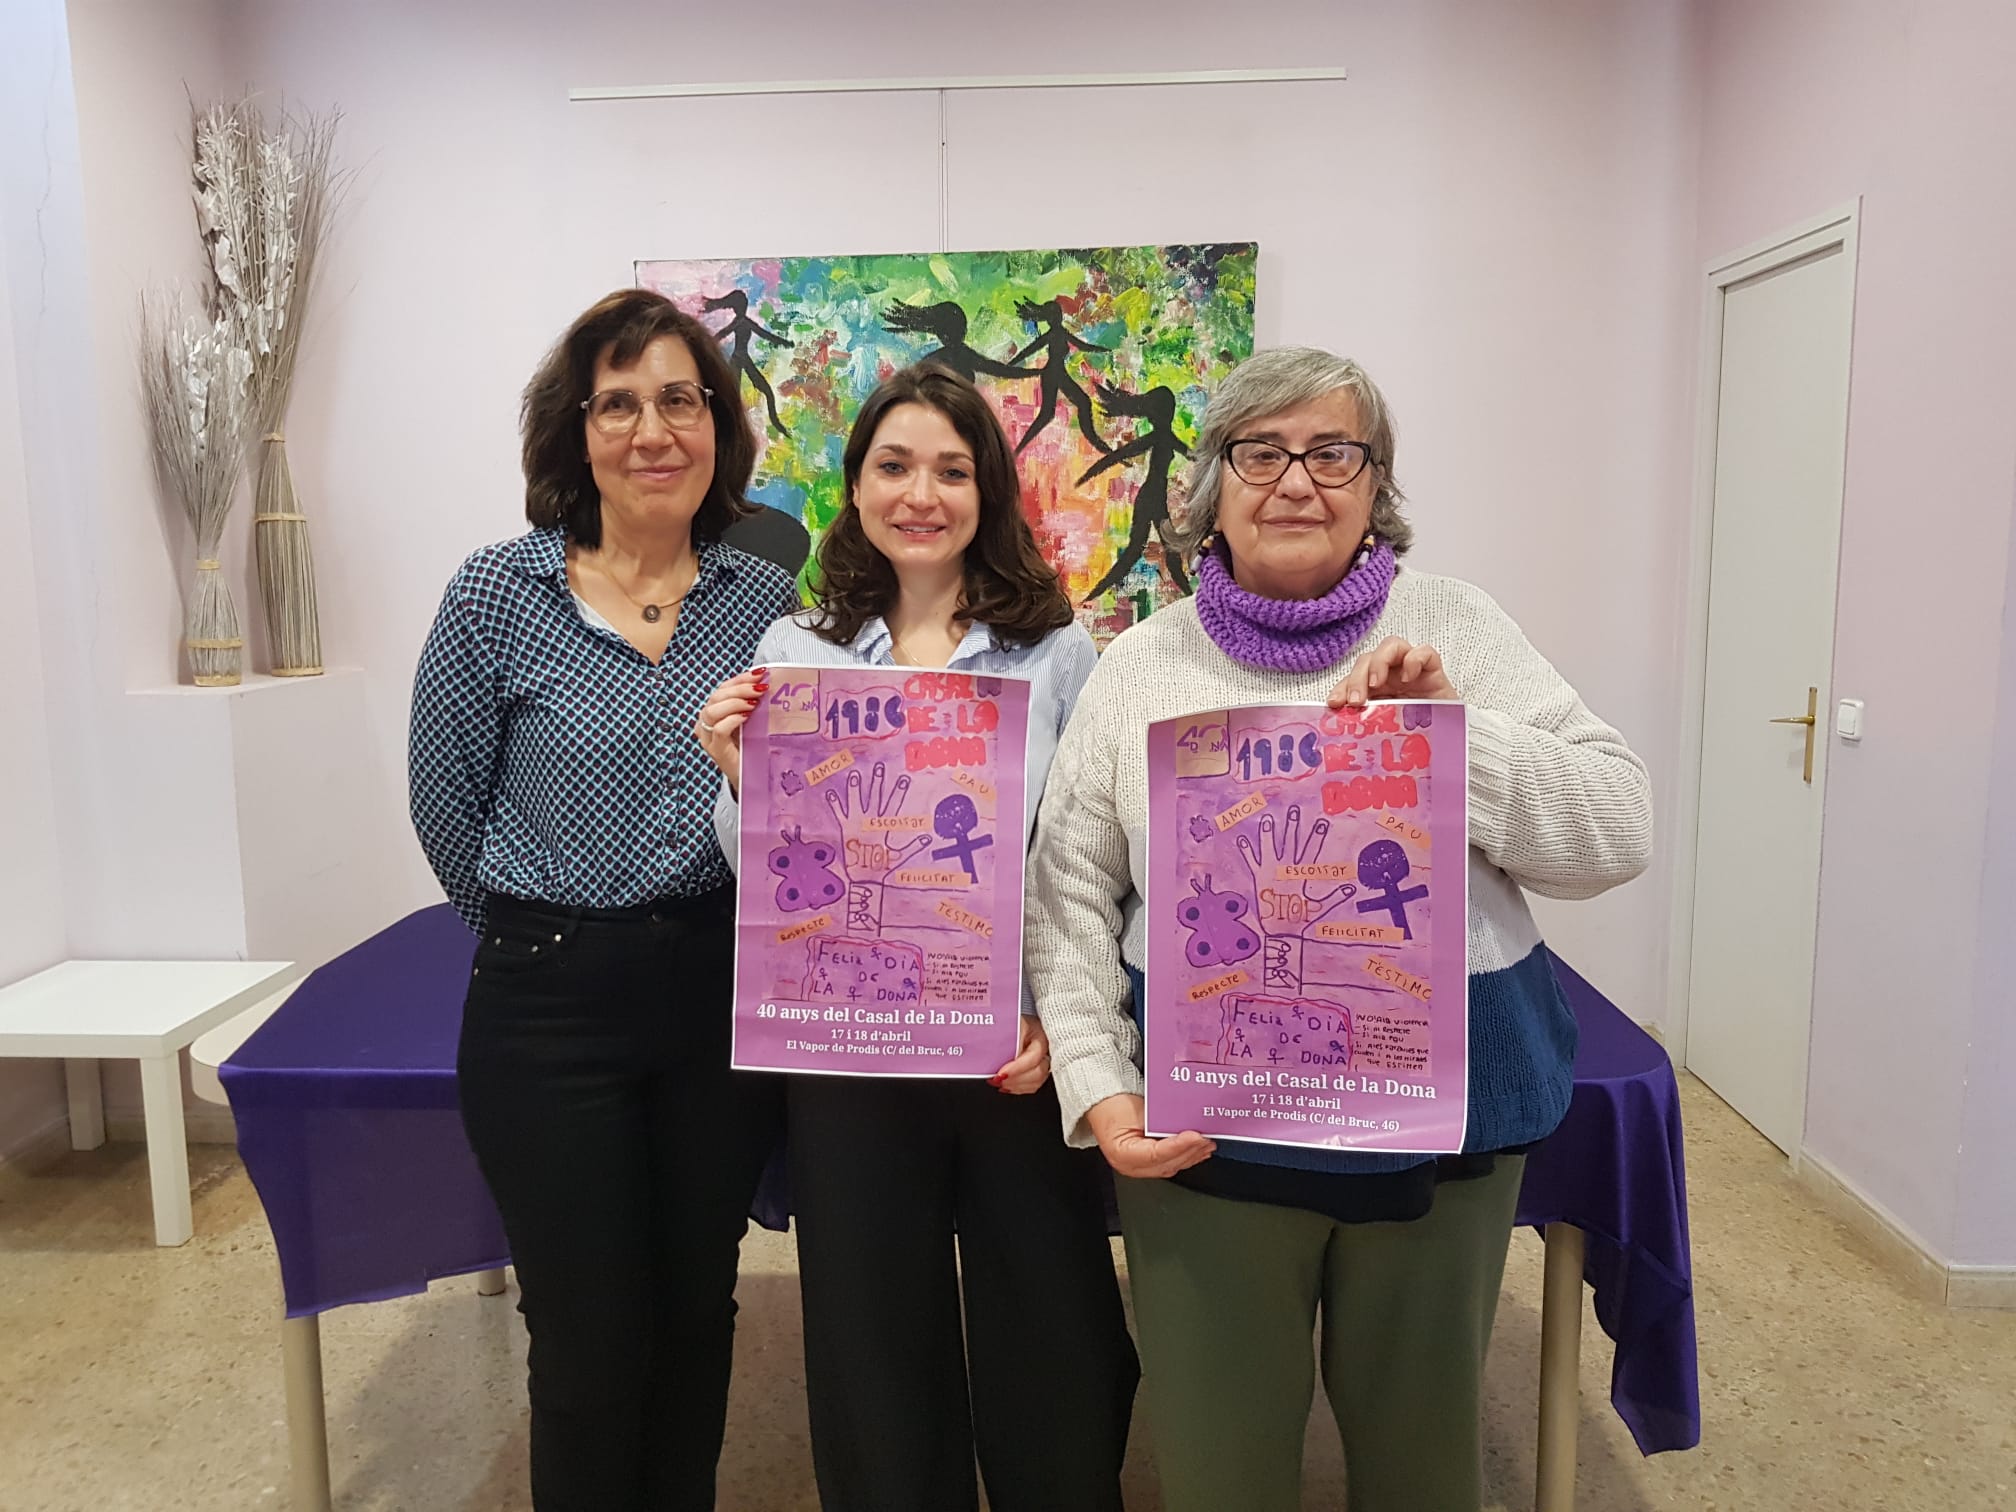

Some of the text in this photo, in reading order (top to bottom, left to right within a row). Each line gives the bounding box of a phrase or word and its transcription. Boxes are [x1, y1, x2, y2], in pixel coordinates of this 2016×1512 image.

[825, 695, 906, 739] 1986
[811, 753, 850, 781] AMOR
[1236, 732, 1323, 781] 1986
[960, 773, 989, 794] PAU
[1221, 797, 1263, 827] AMOR
[1386, 817, 1422, 839] PAU
[846, 839, 901, 871] STOP
[1260, 888, 1322, 923] STOP
[814, 981, 918, 1000] LA DONA
[757, 1004, 994, 1025] 40 anys del Casal de la Dona
[831, 1029, 911, 1041] 17 i 18 d'abril
[787, 1040, 963, 1056] El Vapor de Prodis (C/ del Bruc, 46)
[1230, 1042, 1347, 1066] LA DONA
[1170, 1067, 1436, 1099] 40 anys del Casal de la Dona
[1252, 1094, 1341, 1110] 17 i 18 d'abril
[1203, 1107, 1399, 1132] El Vapor de Prodis (C/ del Bruc, 46)
